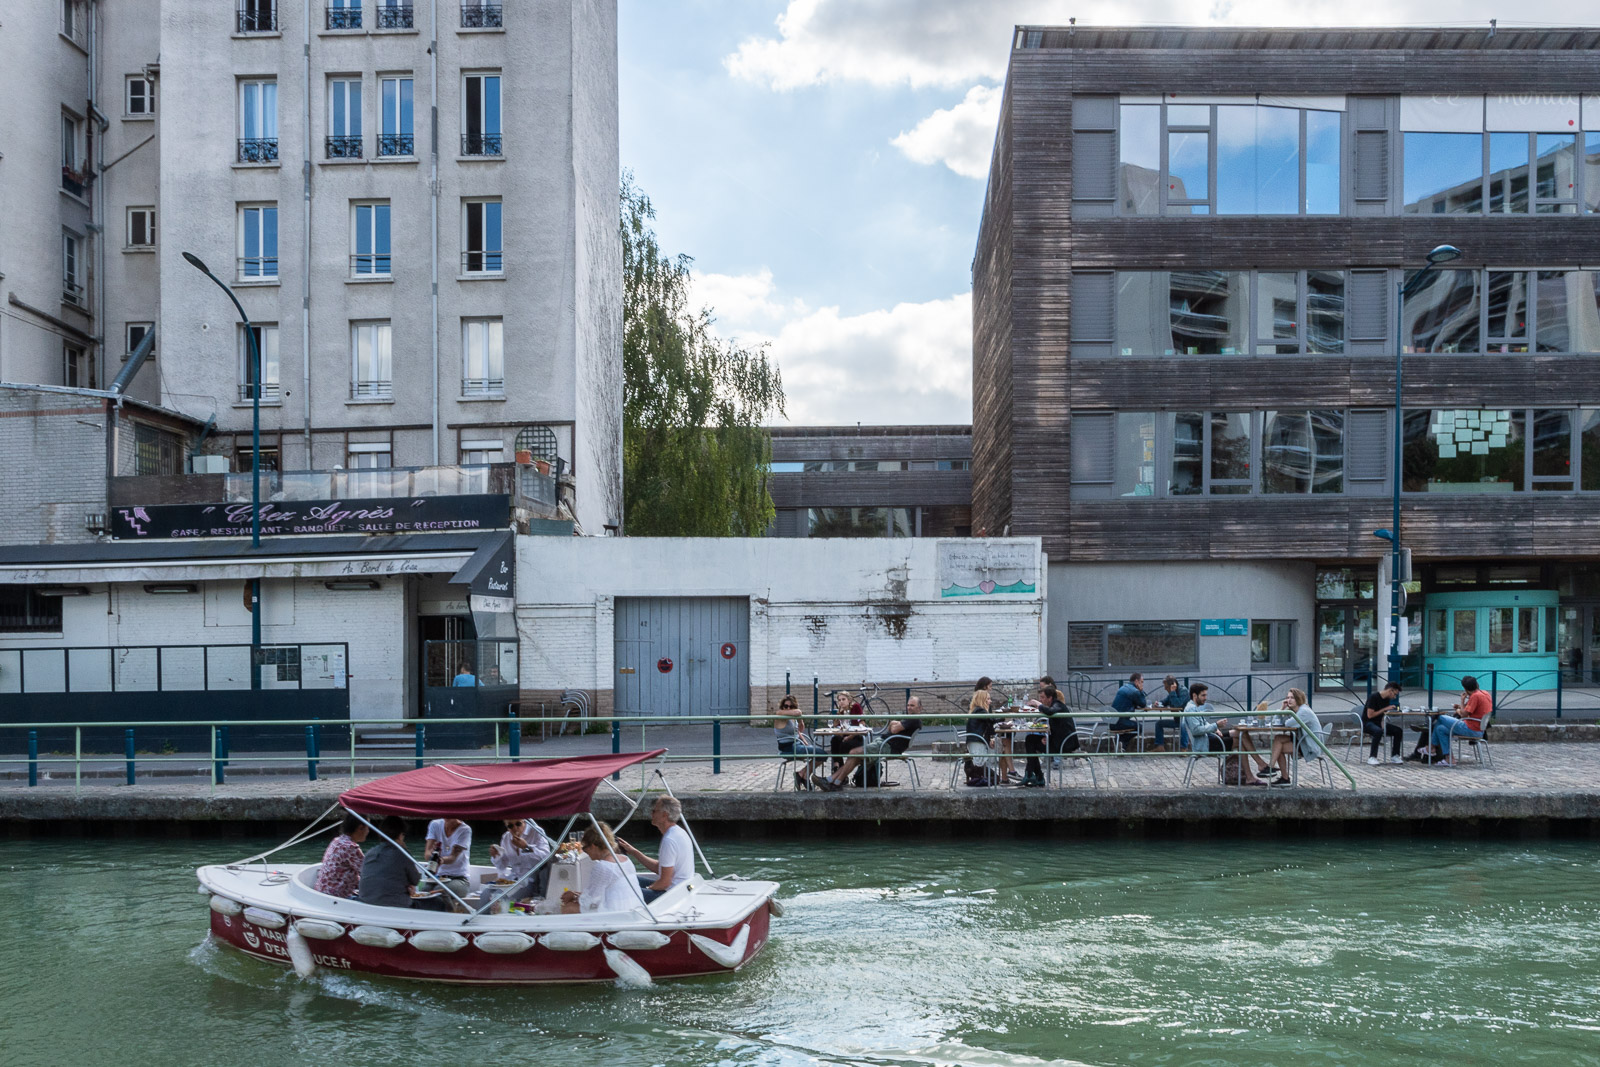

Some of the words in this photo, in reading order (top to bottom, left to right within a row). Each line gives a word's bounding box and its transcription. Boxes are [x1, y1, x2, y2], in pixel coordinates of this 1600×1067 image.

[224, 504, 296, 523] Chez
[302, 502, 394, 526] Agnès
[211, 526, 282, 535] RESTAUANT
[293, 523, 345, 533] BANQUET
[358, 523, 392, 531] SALLE
[395, 522, 411, 530] DE
[414, 520, 480, 529] RECEPTION
